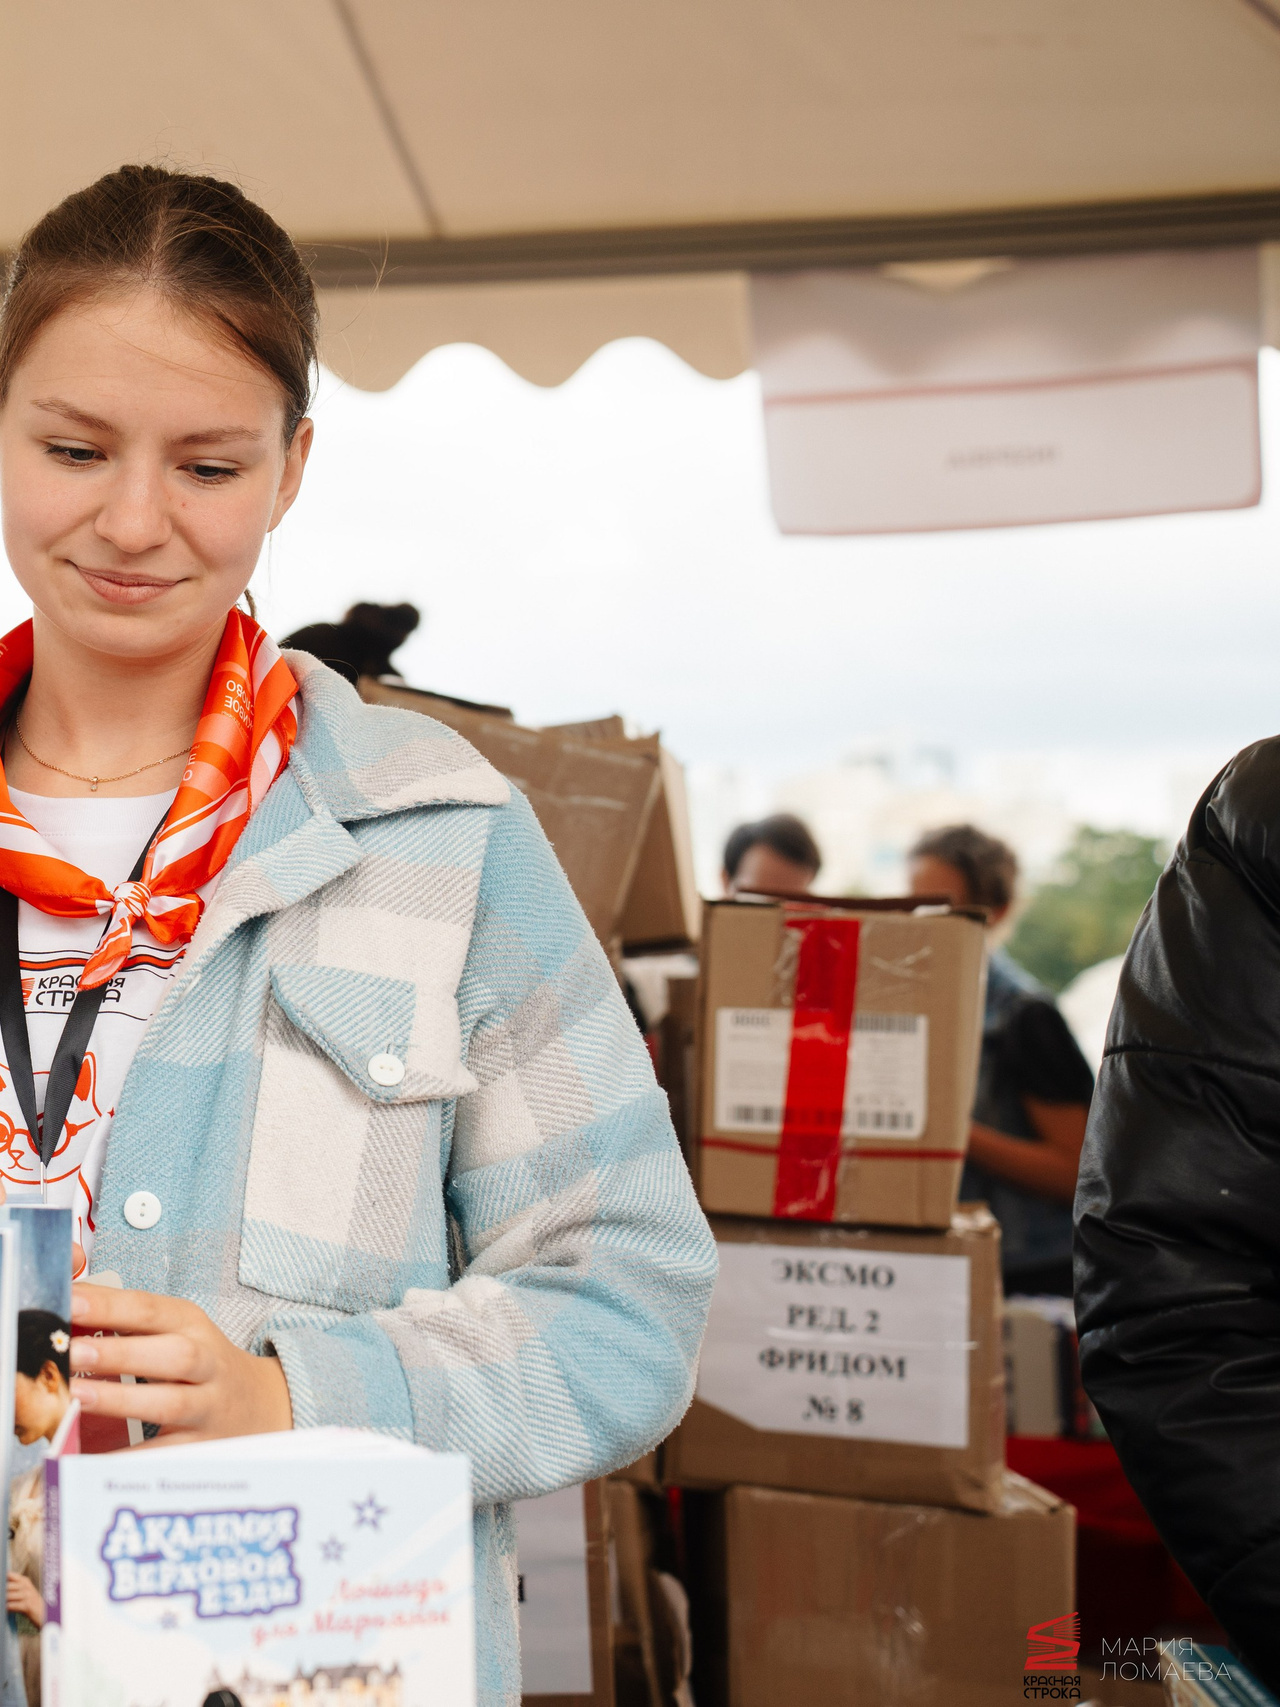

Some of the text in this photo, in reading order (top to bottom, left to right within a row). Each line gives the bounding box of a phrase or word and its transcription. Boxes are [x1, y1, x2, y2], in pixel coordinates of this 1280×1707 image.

[38, 974, 126, 989] КРАЯ
[35, 989, 121, 1007] СТРА
[775, 1259, 895, 1289] ЭКСМО
[787, 1304, 881, 1334] РЕД. 2
[759, 1348, 908, 1380] ФРИДОМ
[802, 1396, 865, 1423] № 8
